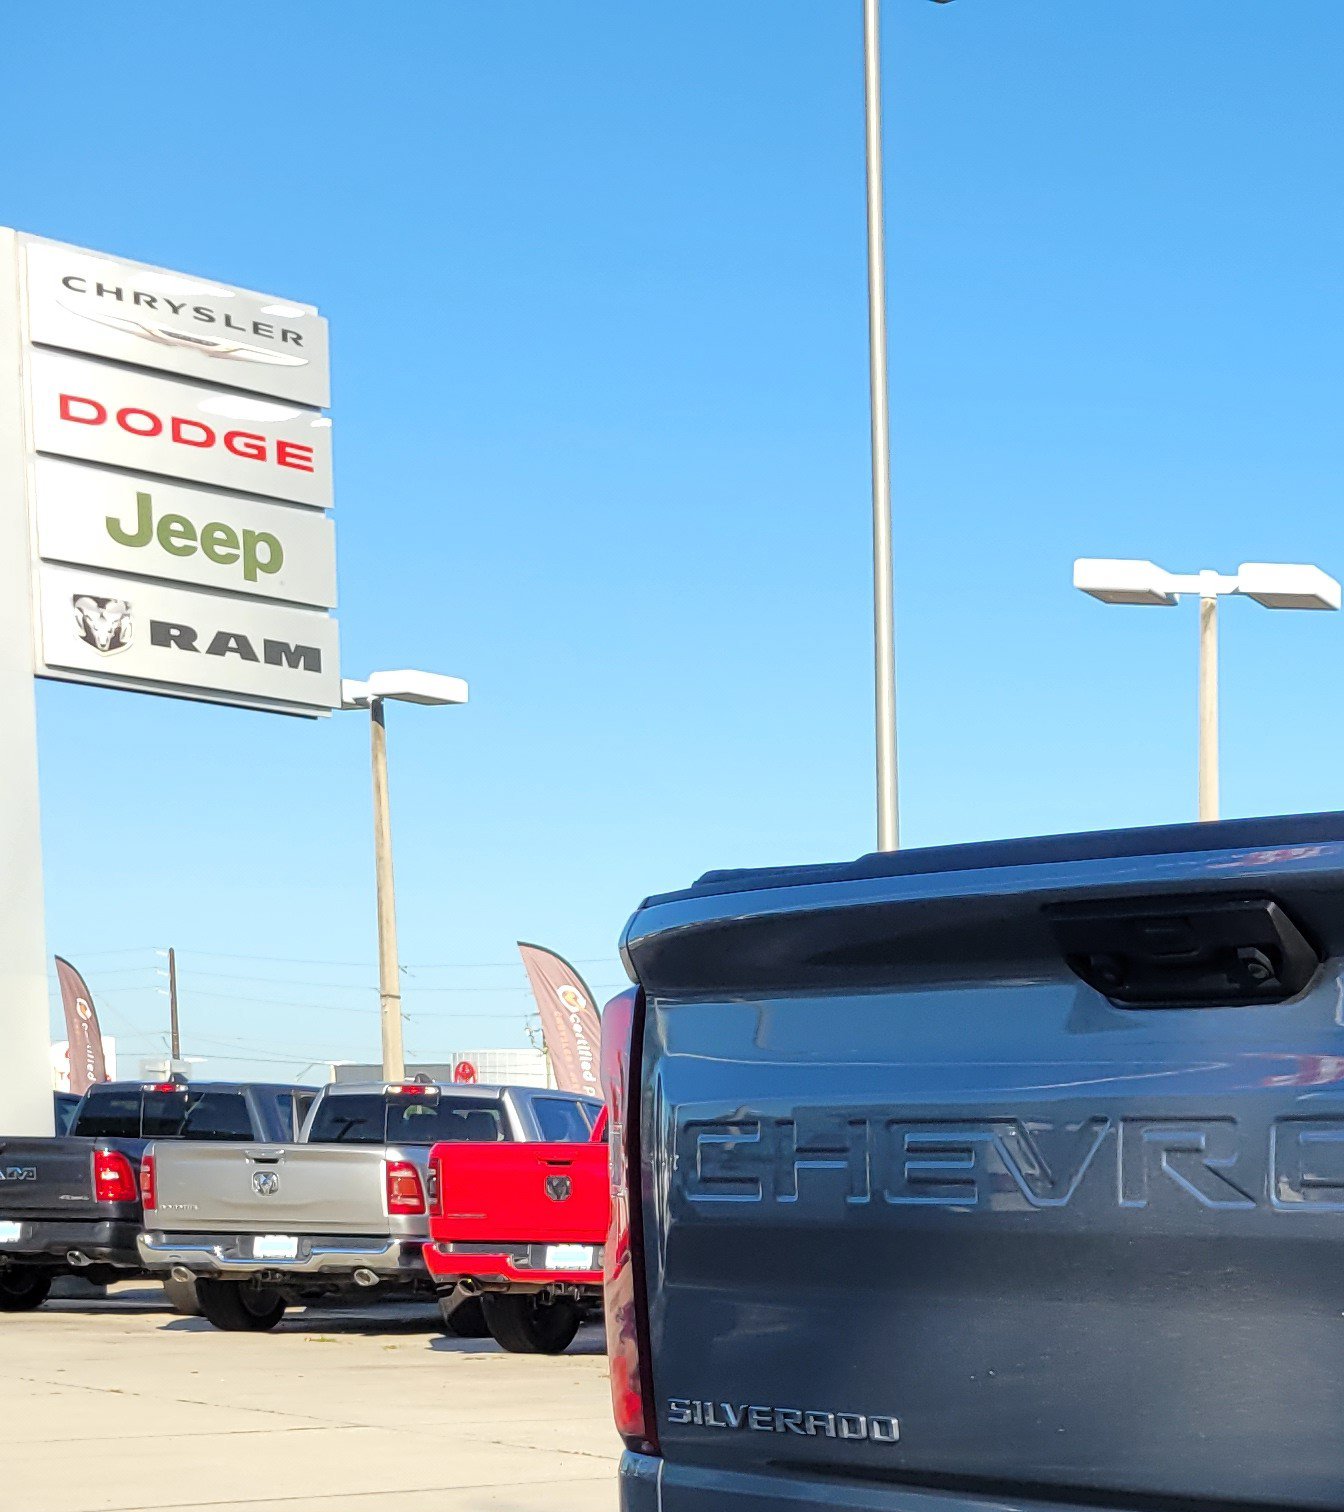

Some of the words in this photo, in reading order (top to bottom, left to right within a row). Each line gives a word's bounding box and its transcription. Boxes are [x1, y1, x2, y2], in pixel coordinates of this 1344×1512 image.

[61, 275, 304, 348] CHRYSLER
[59, 393, 314, 473] DODGE
[106, 491, 284, 582] Jeep
[150, 619, 322, 673] RAM
[666, 1397, 902, 1444] SILVERADO
